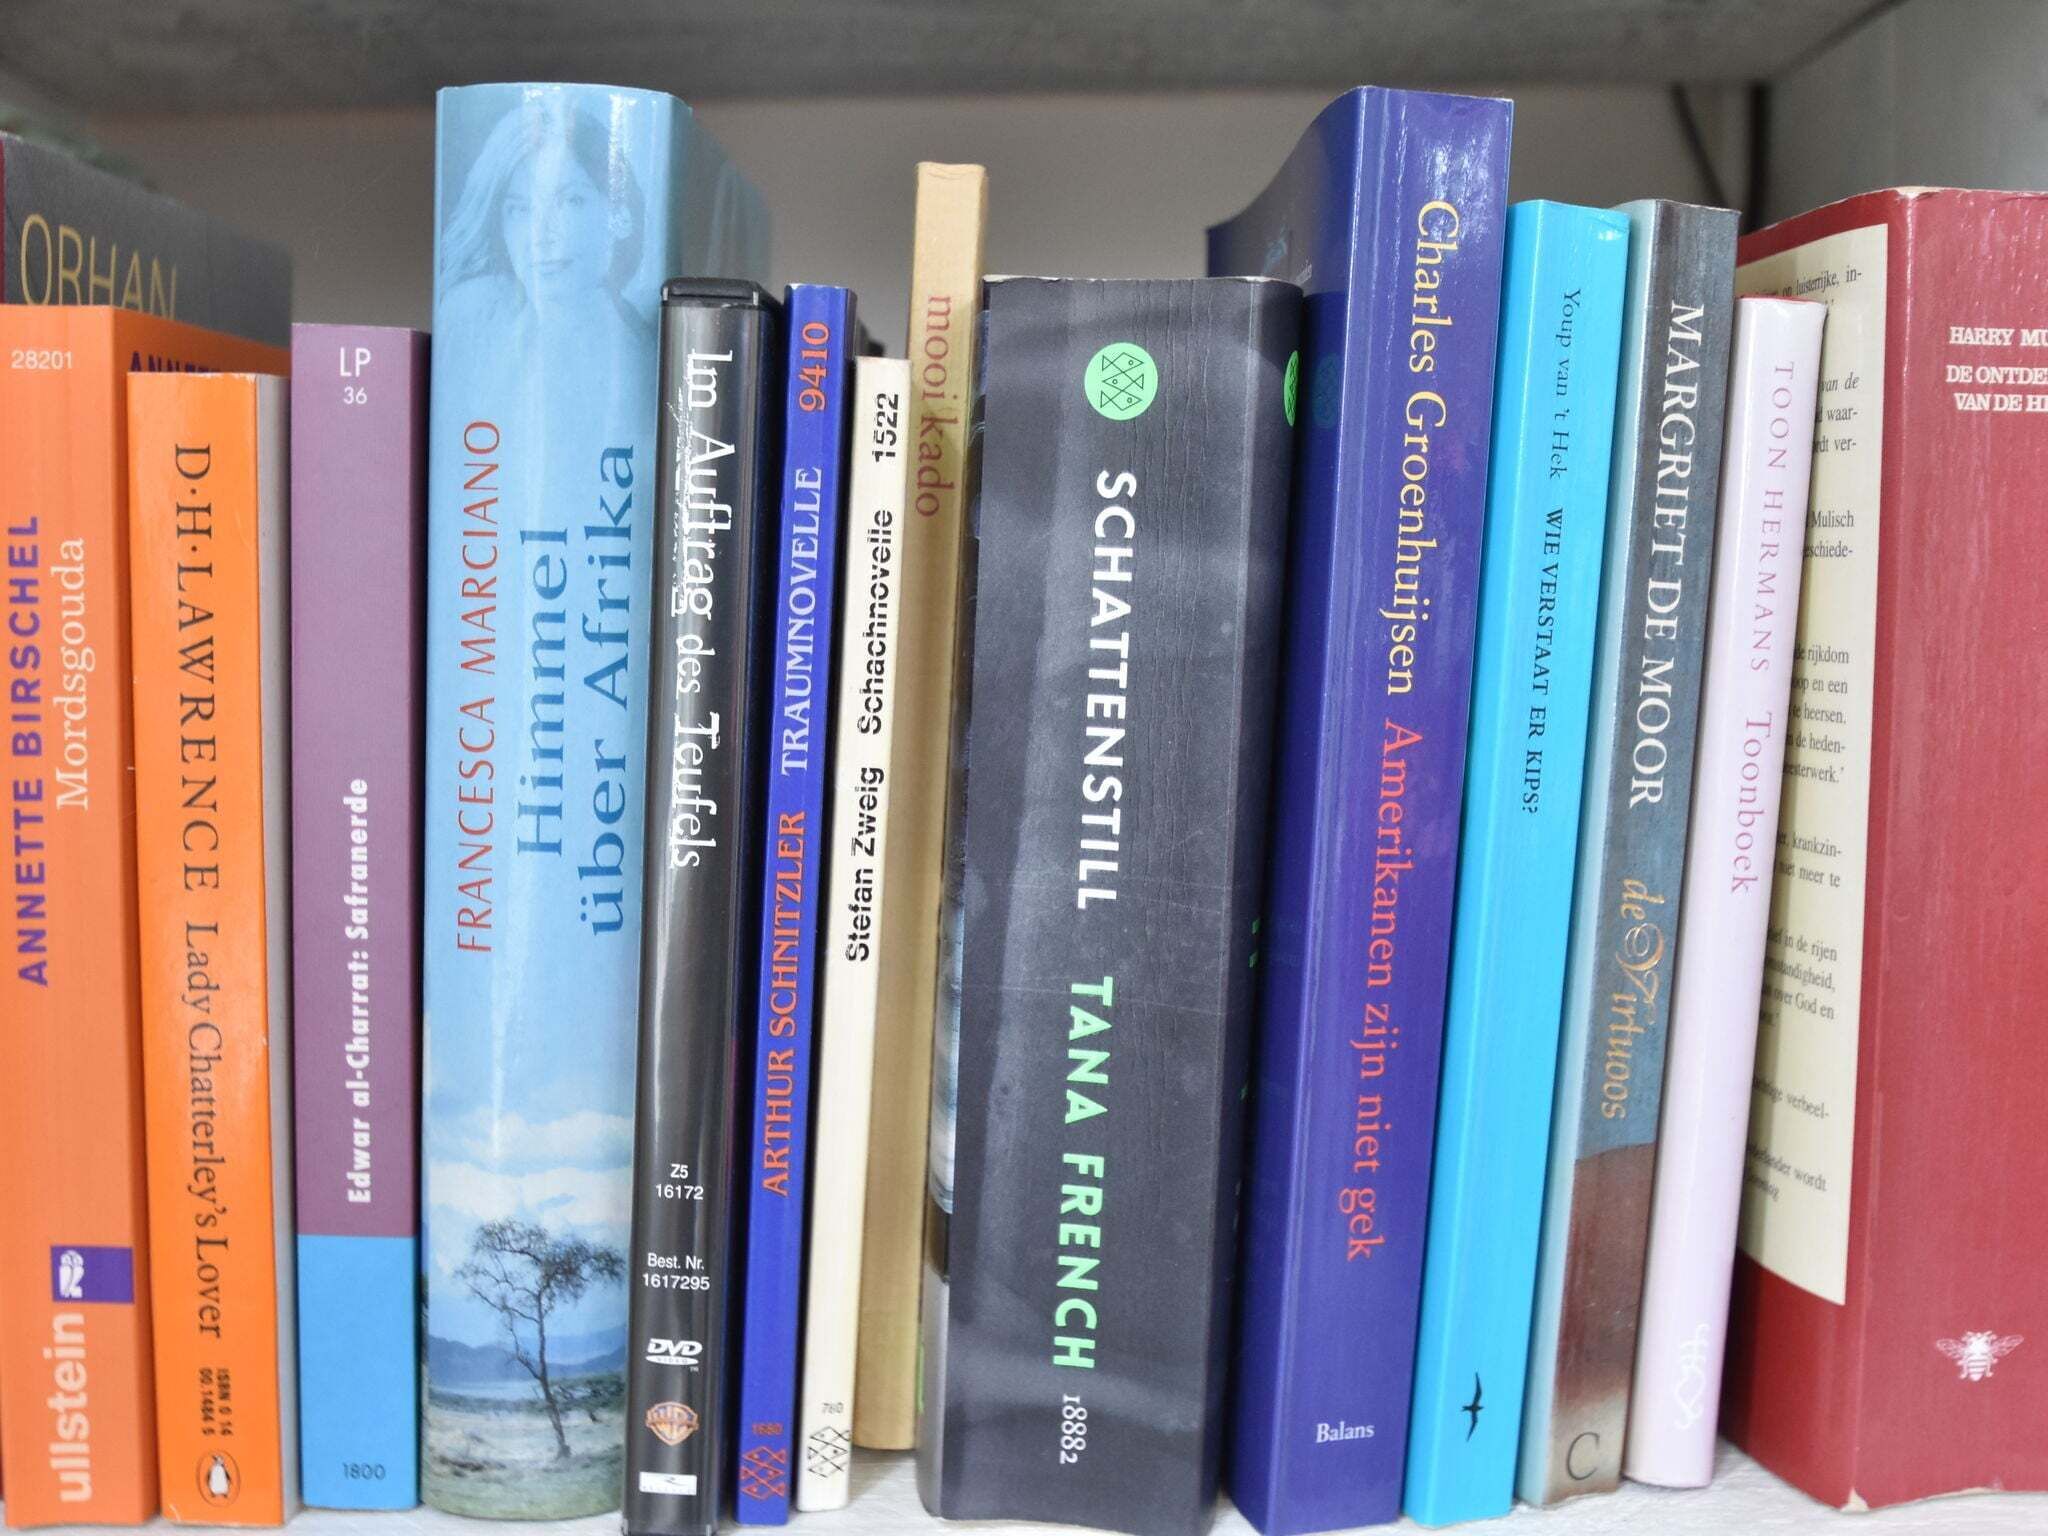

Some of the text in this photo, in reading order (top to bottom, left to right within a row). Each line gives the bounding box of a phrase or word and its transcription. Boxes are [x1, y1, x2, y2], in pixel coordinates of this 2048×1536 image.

[20, 213, 178, 319] ORHAN
[1555, 289, 1582, 351] Youp
[1949, 326, 2015, 346] HARRY
[11, 350, 74, 370] 28201
[340, 347, 372, 377] LP
[1555, 358, 1571, 398] van
[1845, 371, 1860, 389] de
[1945, 364, 1973, 383] DE
[343, 387, 368, 405] 36
[916, 296, 958, 518] mooi kado
[1827, 407, 1858, 421] waar-
[1953, 392, 1992, 411] VAN
[1992, 394, 2023, 412] DE
[1549, 430, 1571, 481] Hek
[1834, 438, 1857, 451] ver-
[1543, 507, 1564, 556] WIE
[1811, 510, 1854, 528] Mulisch
[1630, 300, 1705, 808] MARGRIET DE MOOR
[669, 349, 736, 870] Im Auftrag des Teufels
[1530, 563, 1560, 695] VERSTAAT
[1730, 361, 1795, 895] TOON HERMANS Toonboek
[51, 537, 95, 811] Mordsgouda
[1807, 645, 1850, 666] rijkdom
[456, 421, 500, 953] FRANCESCA MARCIANO
[516, 527, 568, 857] Himmel
[578, 444, 634, 936] über Afrika
[845, 393, 900, 961] Stefan Zweig Schachnovelle 1522
[1812, 679, 1824, 692] en
[1828, 680, 1848, 694] een
[1339, 200, 1460, 1262] Charles Groenhuijsen Amerikanen zijn niet gek
[1528, 706, 1547, 739] ER
[1810, 731, 1846, 753] heden-
[8, 515, 48, 986] ANNETTE BIRSCHEL
[762, 321, 830, 1199] ARTHUR SCHNITZLER TRAUMNOVELLE 9410
[1521, 749, 1545, 814] KIPS?
[1622, 878, 1665, 921] de
[1830, 873, 1841, 888] te
[182, 921, 221, 1016] Lady
[1053, 470, 1137, 1465] SCHATTENSTILL TANA FRENCH 18882
[343, 778, 371, 1203] Edwar al-Charrat: Safranerde
[1795, 992, 1817, 1014] God
[1820, 1005, 1835, 1020] en
[670, 1164, 688, 1178] Z5
[655, 1184, 704, 1200] 16172
[642, 1274, 710, 1290] 1617295
[647, 1253, 705, 1270] Best. Nr.
[195, 1234, 229, 1339] Lover
[648, 1338, 702, 1356] DVD
[43, 1312, 91, 1502] ullstein
[1316, 1421, 1375, 1443] Balans
[342, 1462, 386, 1480] 1800
